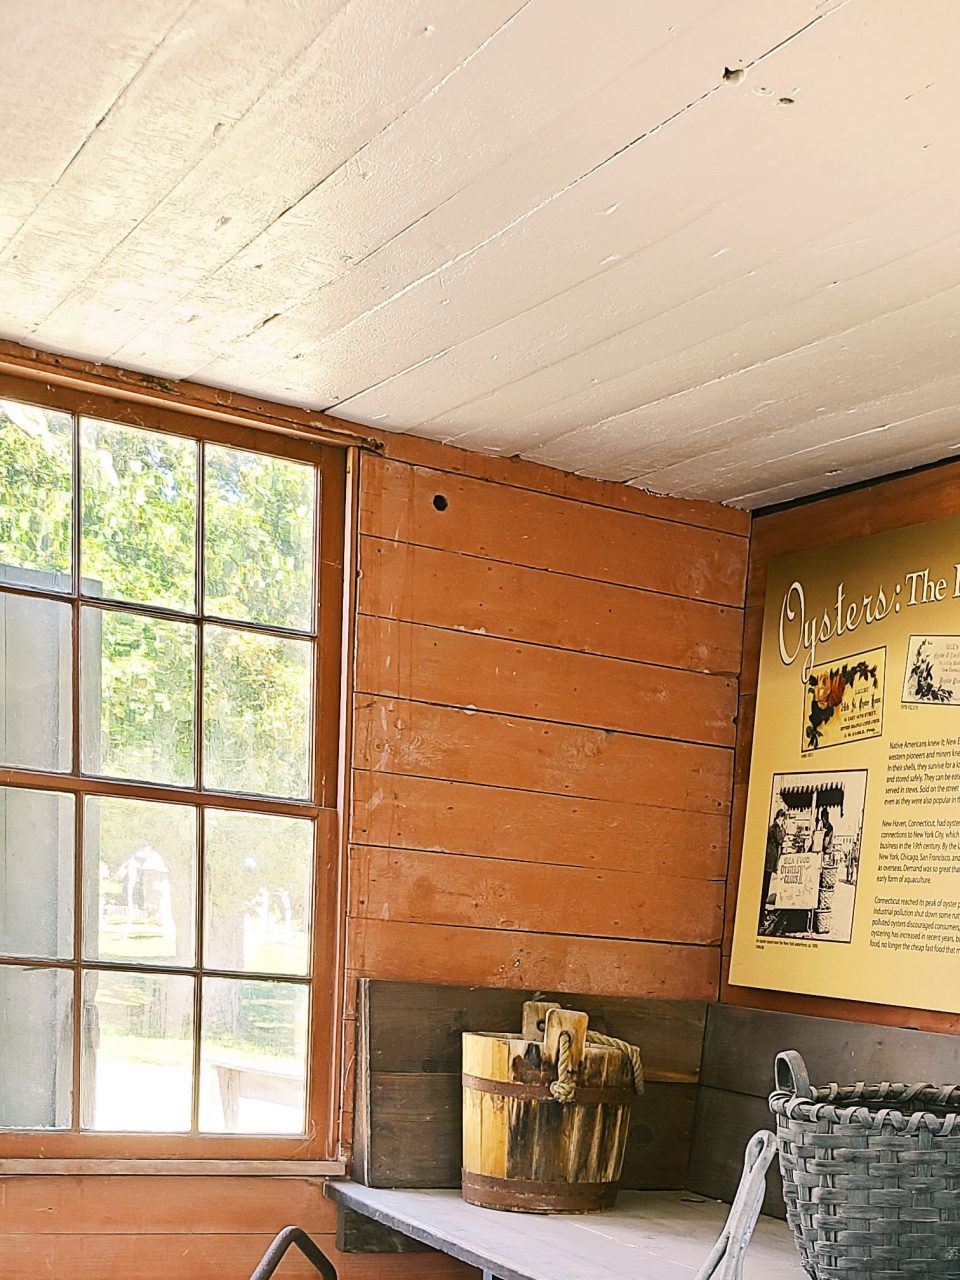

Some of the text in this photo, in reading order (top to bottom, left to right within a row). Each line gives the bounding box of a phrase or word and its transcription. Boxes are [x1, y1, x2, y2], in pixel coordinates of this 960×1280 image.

[778, 581, 901, 684] Oysters:
[905, 568, 947, 606] The
[906, 752, 925, 761] pioneers
[885, 786, 899, 794] served
[945, 784, 959, 792] street
[933, 796, 951, 806] popular
[903, 864, 922, 872] Demand
[874, 897, 900, 905] Connecticut
[901, 898, 918, 906] reached
[943, 900, 957, 909] oyster
[873, 908, 893, 916] industrial
[894, 909, 913, 918] pollution
[872, 919, 890, 928] polluted
[891, 920, 906, 929] oysters
[907, 921, 934, 931] discouraged
[871, 930, 890, 940] oystering
[900, 932, 920, 940] increased
[888, 941, 902, 951] longer
